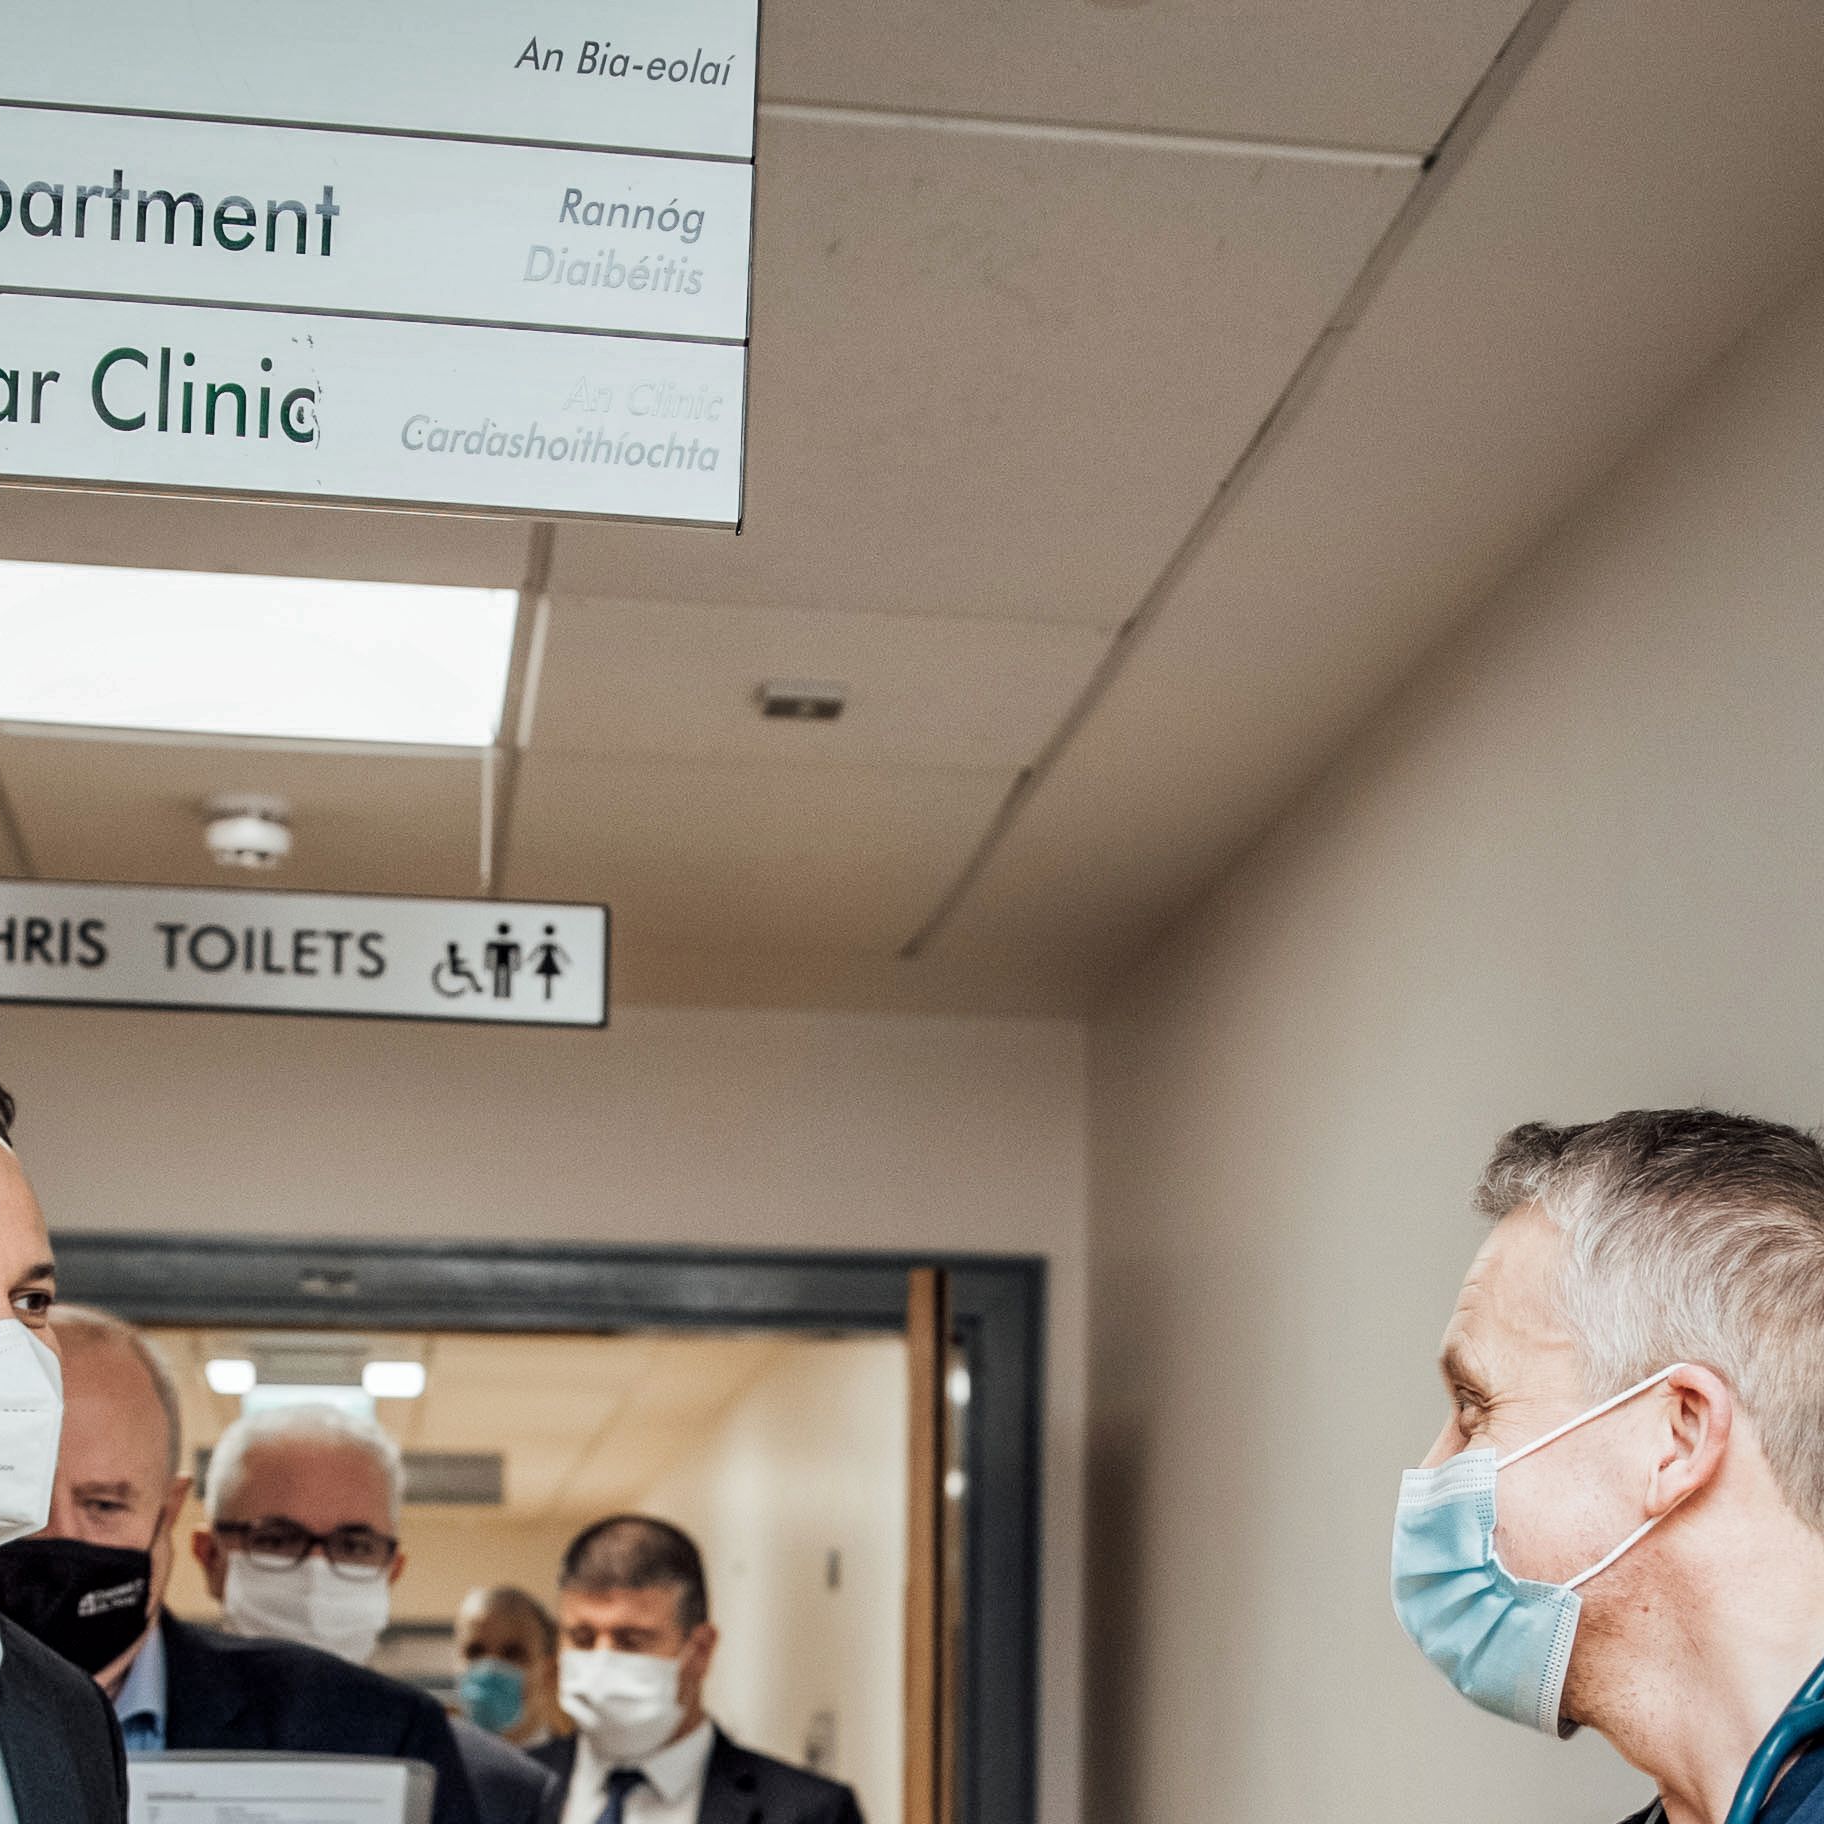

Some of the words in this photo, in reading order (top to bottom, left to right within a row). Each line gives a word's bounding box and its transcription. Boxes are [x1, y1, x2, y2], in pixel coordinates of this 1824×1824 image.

[513, 36, 563, 73] An
[576, 40, 736, 86] Bia-eolaí
[558, 187, 705, 244] Rannóg
[522, 244, 704, 296] Diaibéitis
[91, 345, 317, 444] Clinic
[562, 375, 612, 413] An
[626, 378, 724, 422] Clinic
[156, 922, 387, 980] TOILETS
